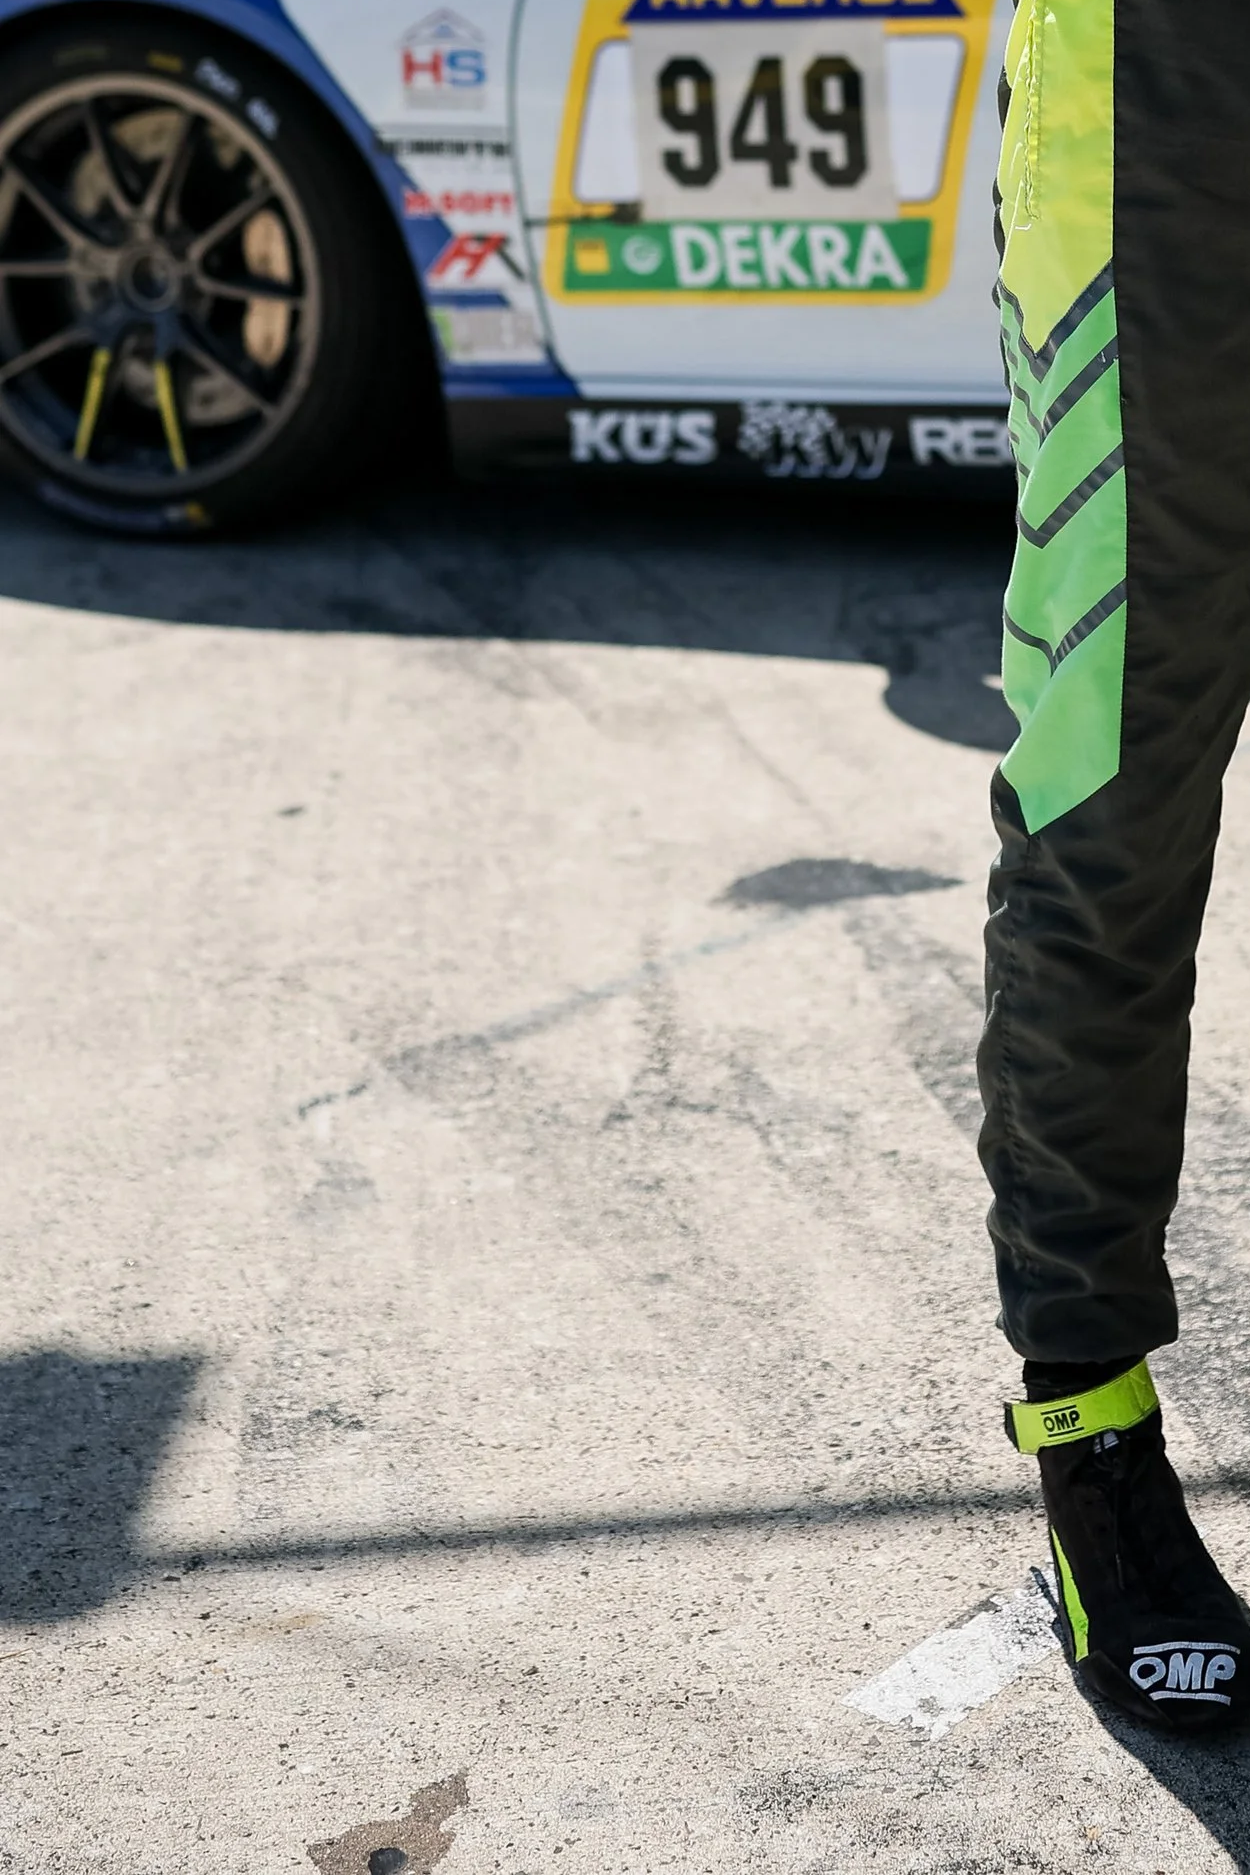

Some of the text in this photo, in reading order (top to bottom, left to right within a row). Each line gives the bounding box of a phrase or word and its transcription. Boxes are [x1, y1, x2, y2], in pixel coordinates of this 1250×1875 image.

[402, 48, 487, 88] HS
[656, 53, 870, 190] 949
[669, 222, 909, 290] DEKRA
[1043, 1408, 1082, 1433] OMP
[1129, 1651, 1237, 1692] OMP
